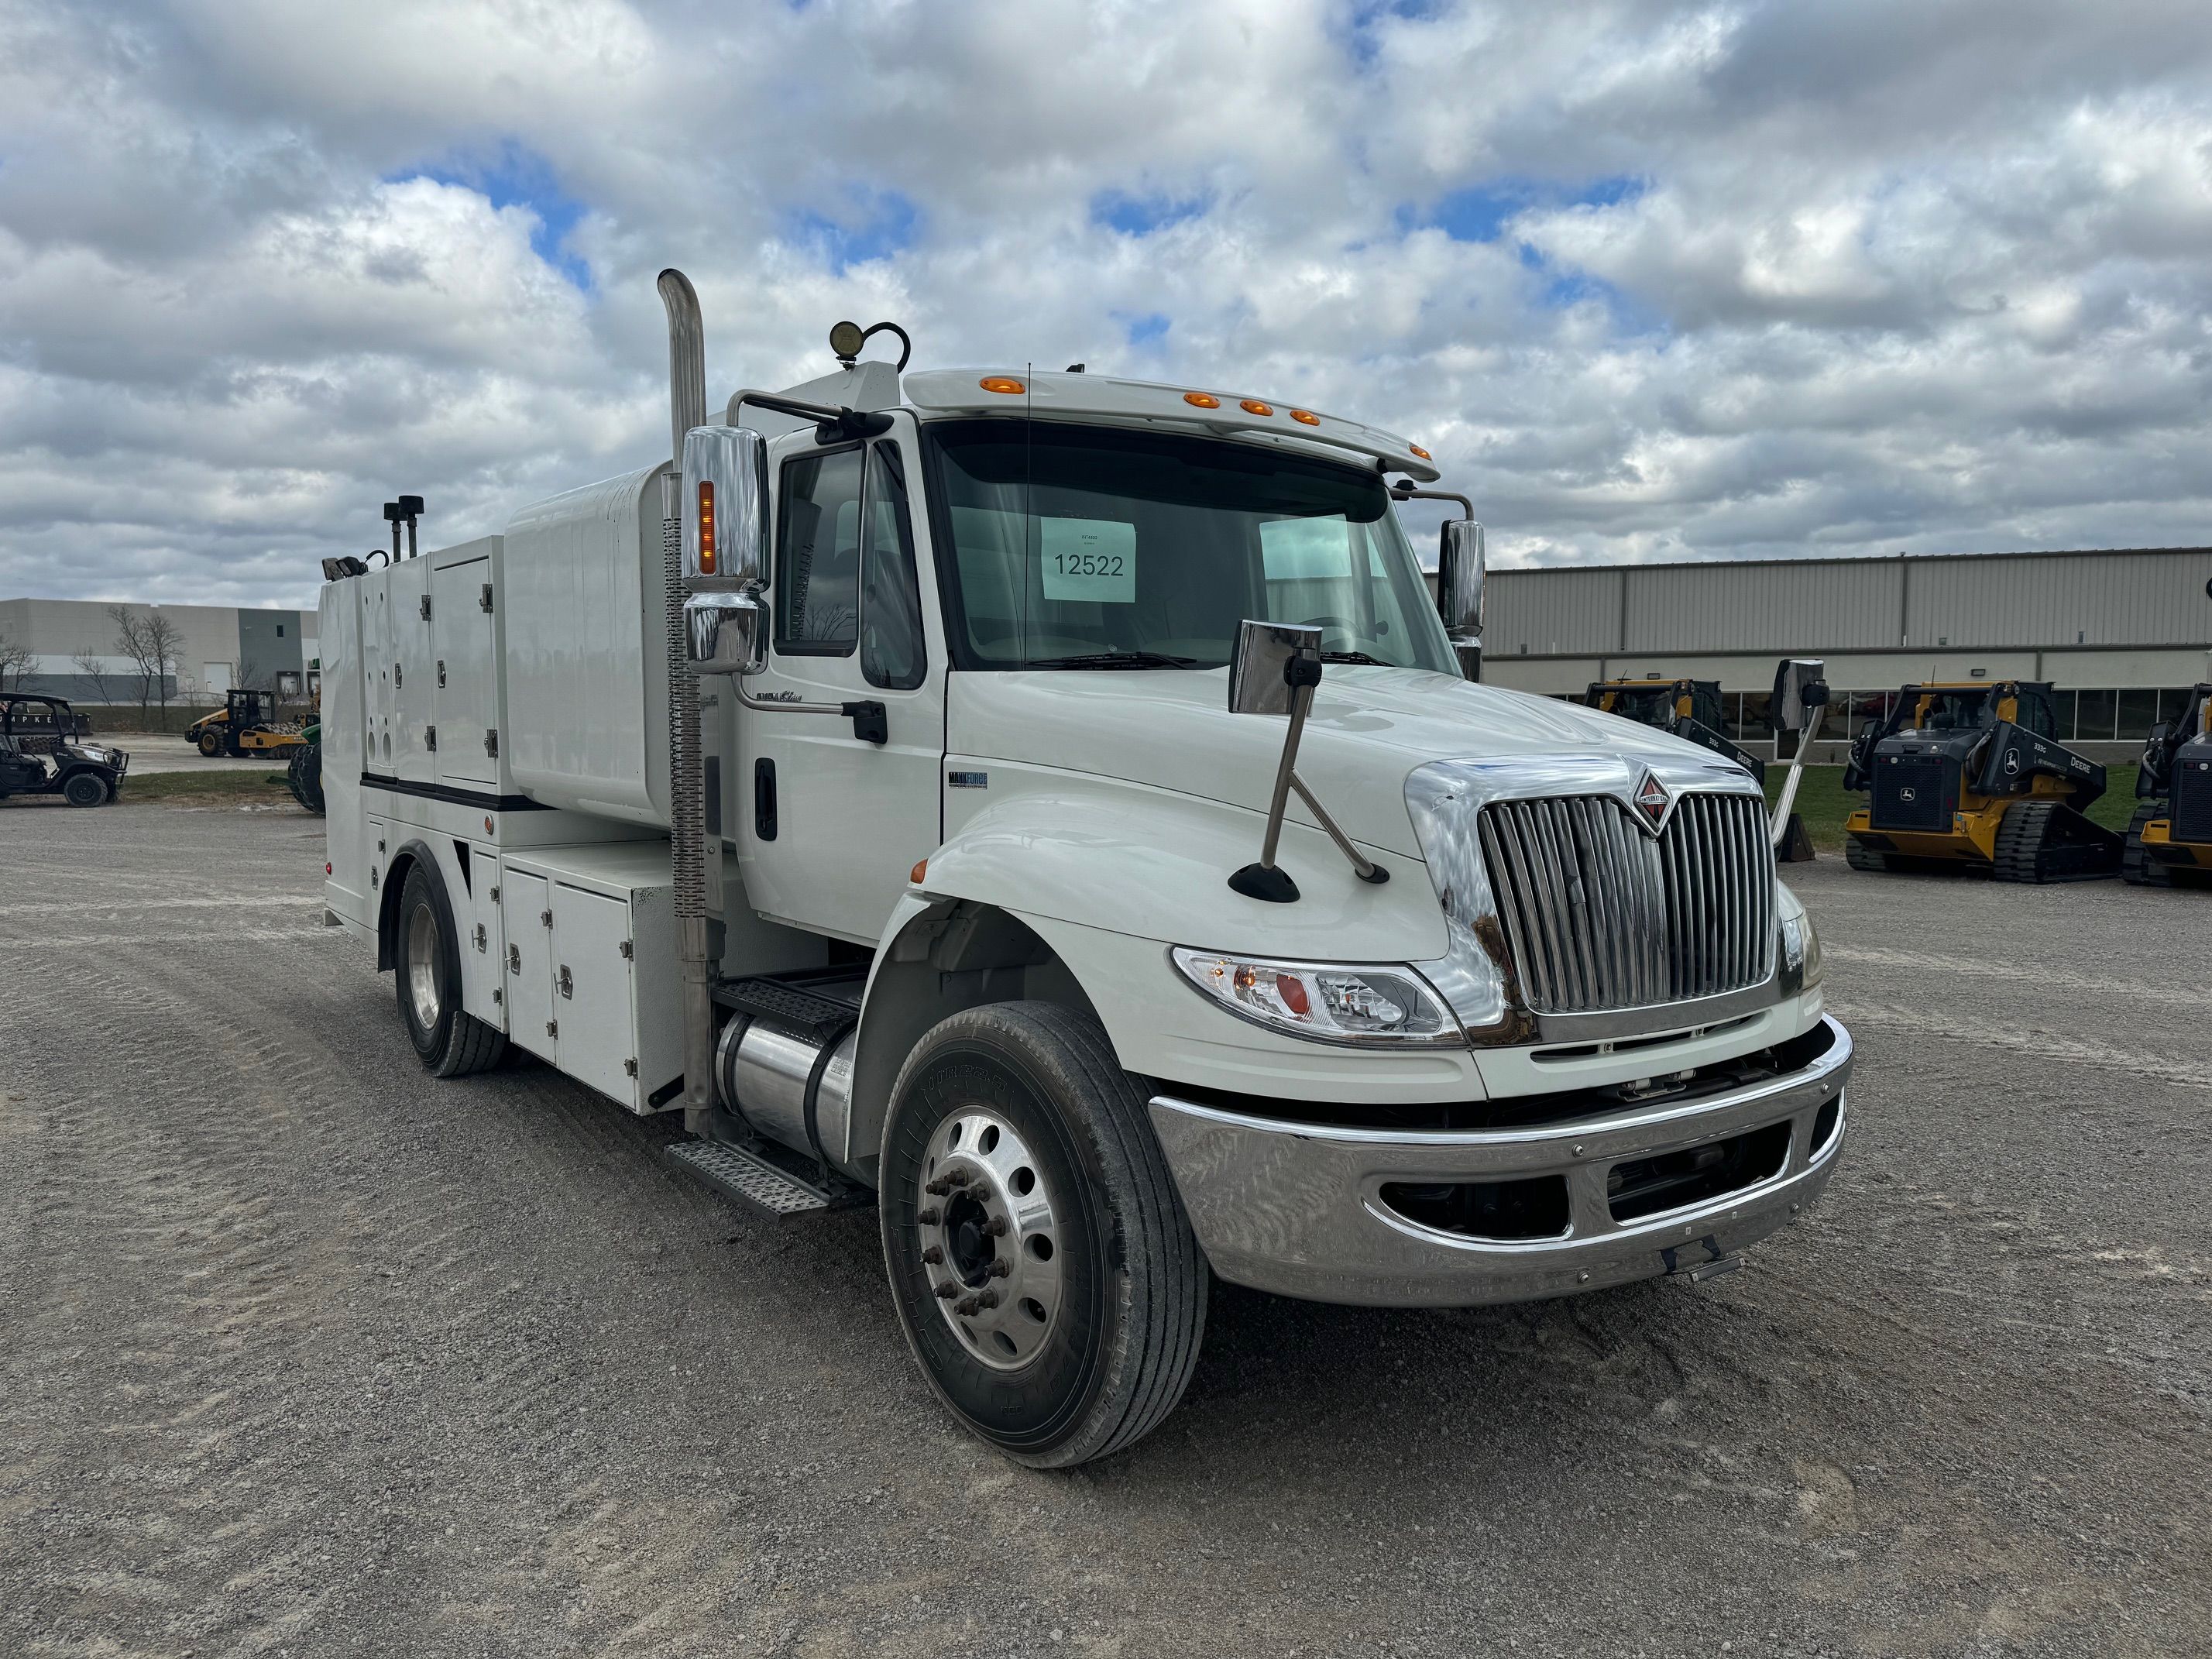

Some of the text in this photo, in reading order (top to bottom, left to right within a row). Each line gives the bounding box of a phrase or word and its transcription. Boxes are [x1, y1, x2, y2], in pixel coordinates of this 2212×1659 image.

[1054, 554, 1124, 576] 12522
[2033, 742, 2047, 754] 333G
[1737, 751, 1753, 768] DEERE
[2070, 756, 2091, 774] DEERE
